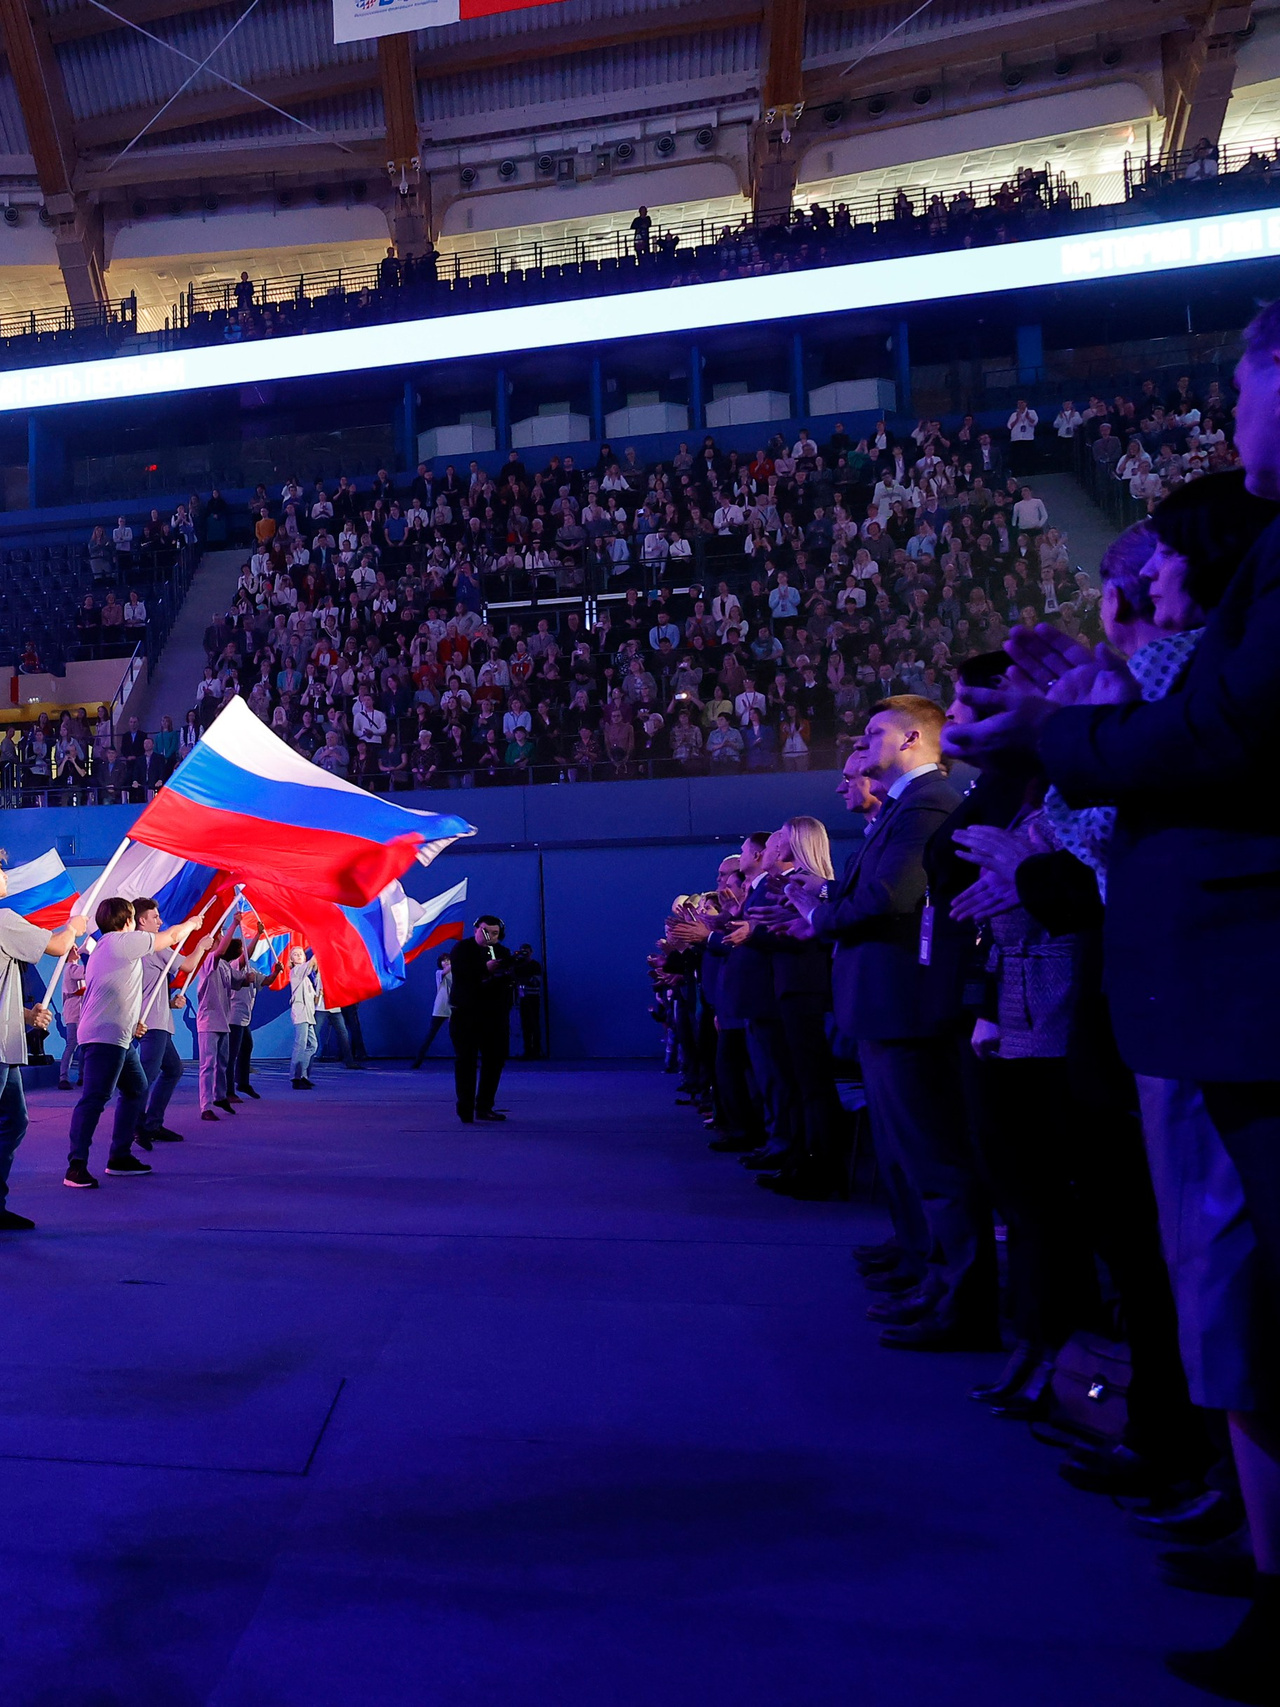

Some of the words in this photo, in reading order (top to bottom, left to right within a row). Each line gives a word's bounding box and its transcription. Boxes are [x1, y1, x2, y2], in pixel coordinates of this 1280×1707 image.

[1061, 228, 1191, 274] ИСТОРИЯ
[1196, 218, 1263, 262] ДЛЯ
[26, 370, 81, 402] БЫТЬ
[85, 357, 185, 395] ПЕРВЫМИ
